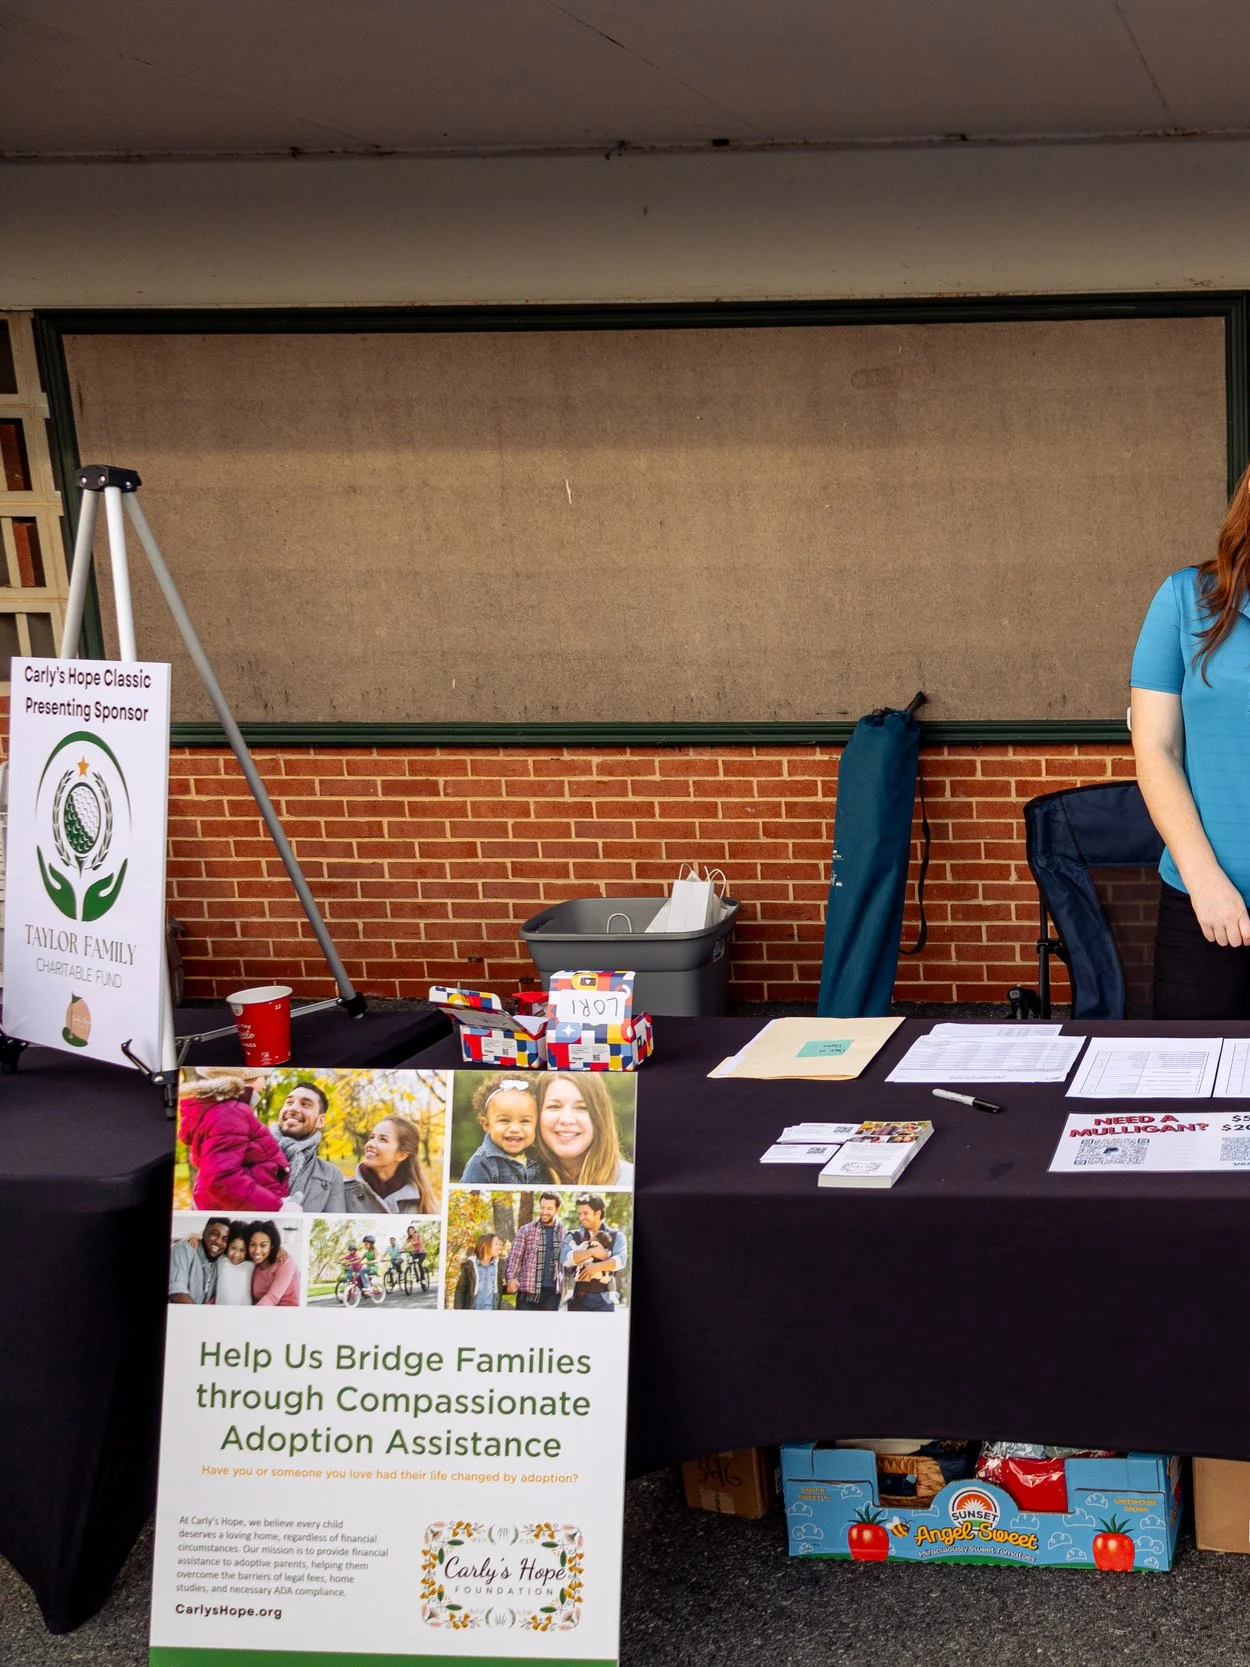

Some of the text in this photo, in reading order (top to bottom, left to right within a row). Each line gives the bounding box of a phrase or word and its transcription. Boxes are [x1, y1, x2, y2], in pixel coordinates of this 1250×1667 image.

[25, 665, 151, 689] Carly's Hope Classic
[26, 697, 148, 722] Presenting Sponsor
[25, 924, 136, 965] TAYLOR FAMILY
[36, 957, 121, 988] CHARITABLE FUND
[572, 997, 618, 1017] LORI
[1069, 1122, 1209, 1137] MULLIGAN?
[1094, 1115, 1154, 1126] NEED
[1160, 1114, 1179, 1123] A
[200, 1341, 590, 1376] Help Us Bridge Families
[196, 1382, 590, 1418] through Compassionate
[220, 1425, 561, 1458] Adoption Assistance
[1114, 1498, 1158, 1506] GREENHOUSE
[952, 1510, 998, 1522] SUNSET
[914, 1522, 1039, 1550] Angel Sweet
[918, 1546, 1036, 1562] Miraculously Sweet Tomatoes
[444, 1556, 566, 1586] Carly's Hope
[454, 1586, 554, 1596] FOUNDATION
[175, 1604, 282, 1620] CarlysHope.org
